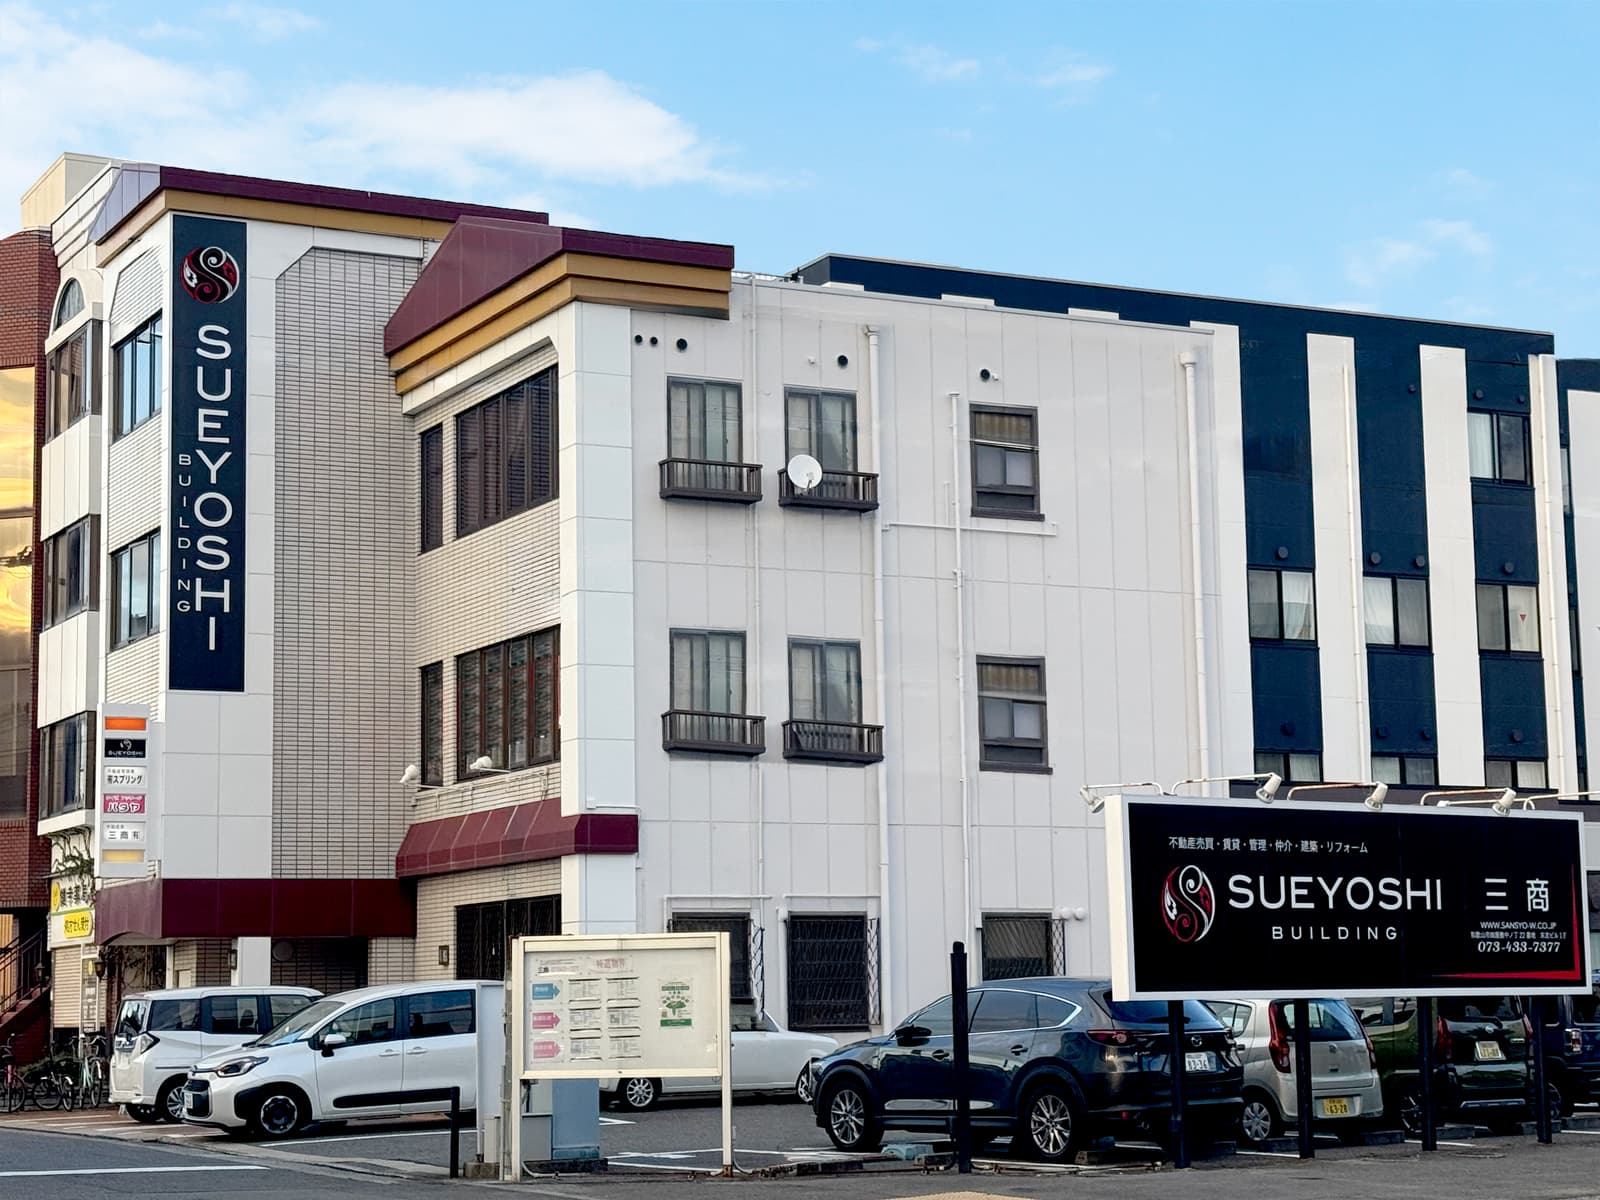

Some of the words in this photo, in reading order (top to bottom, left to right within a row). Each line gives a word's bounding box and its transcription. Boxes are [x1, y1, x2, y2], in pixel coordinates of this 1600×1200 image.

[194, 325, 233, 651] SUEYOSHI
[177, 454, 192, 612] BUILDING
[1228, 874, 1442, 910] SUEYOSHI
[1271, 926, 1397, 940] BUILDING
[1478, 941, 1561, 952] 073-433-7377
